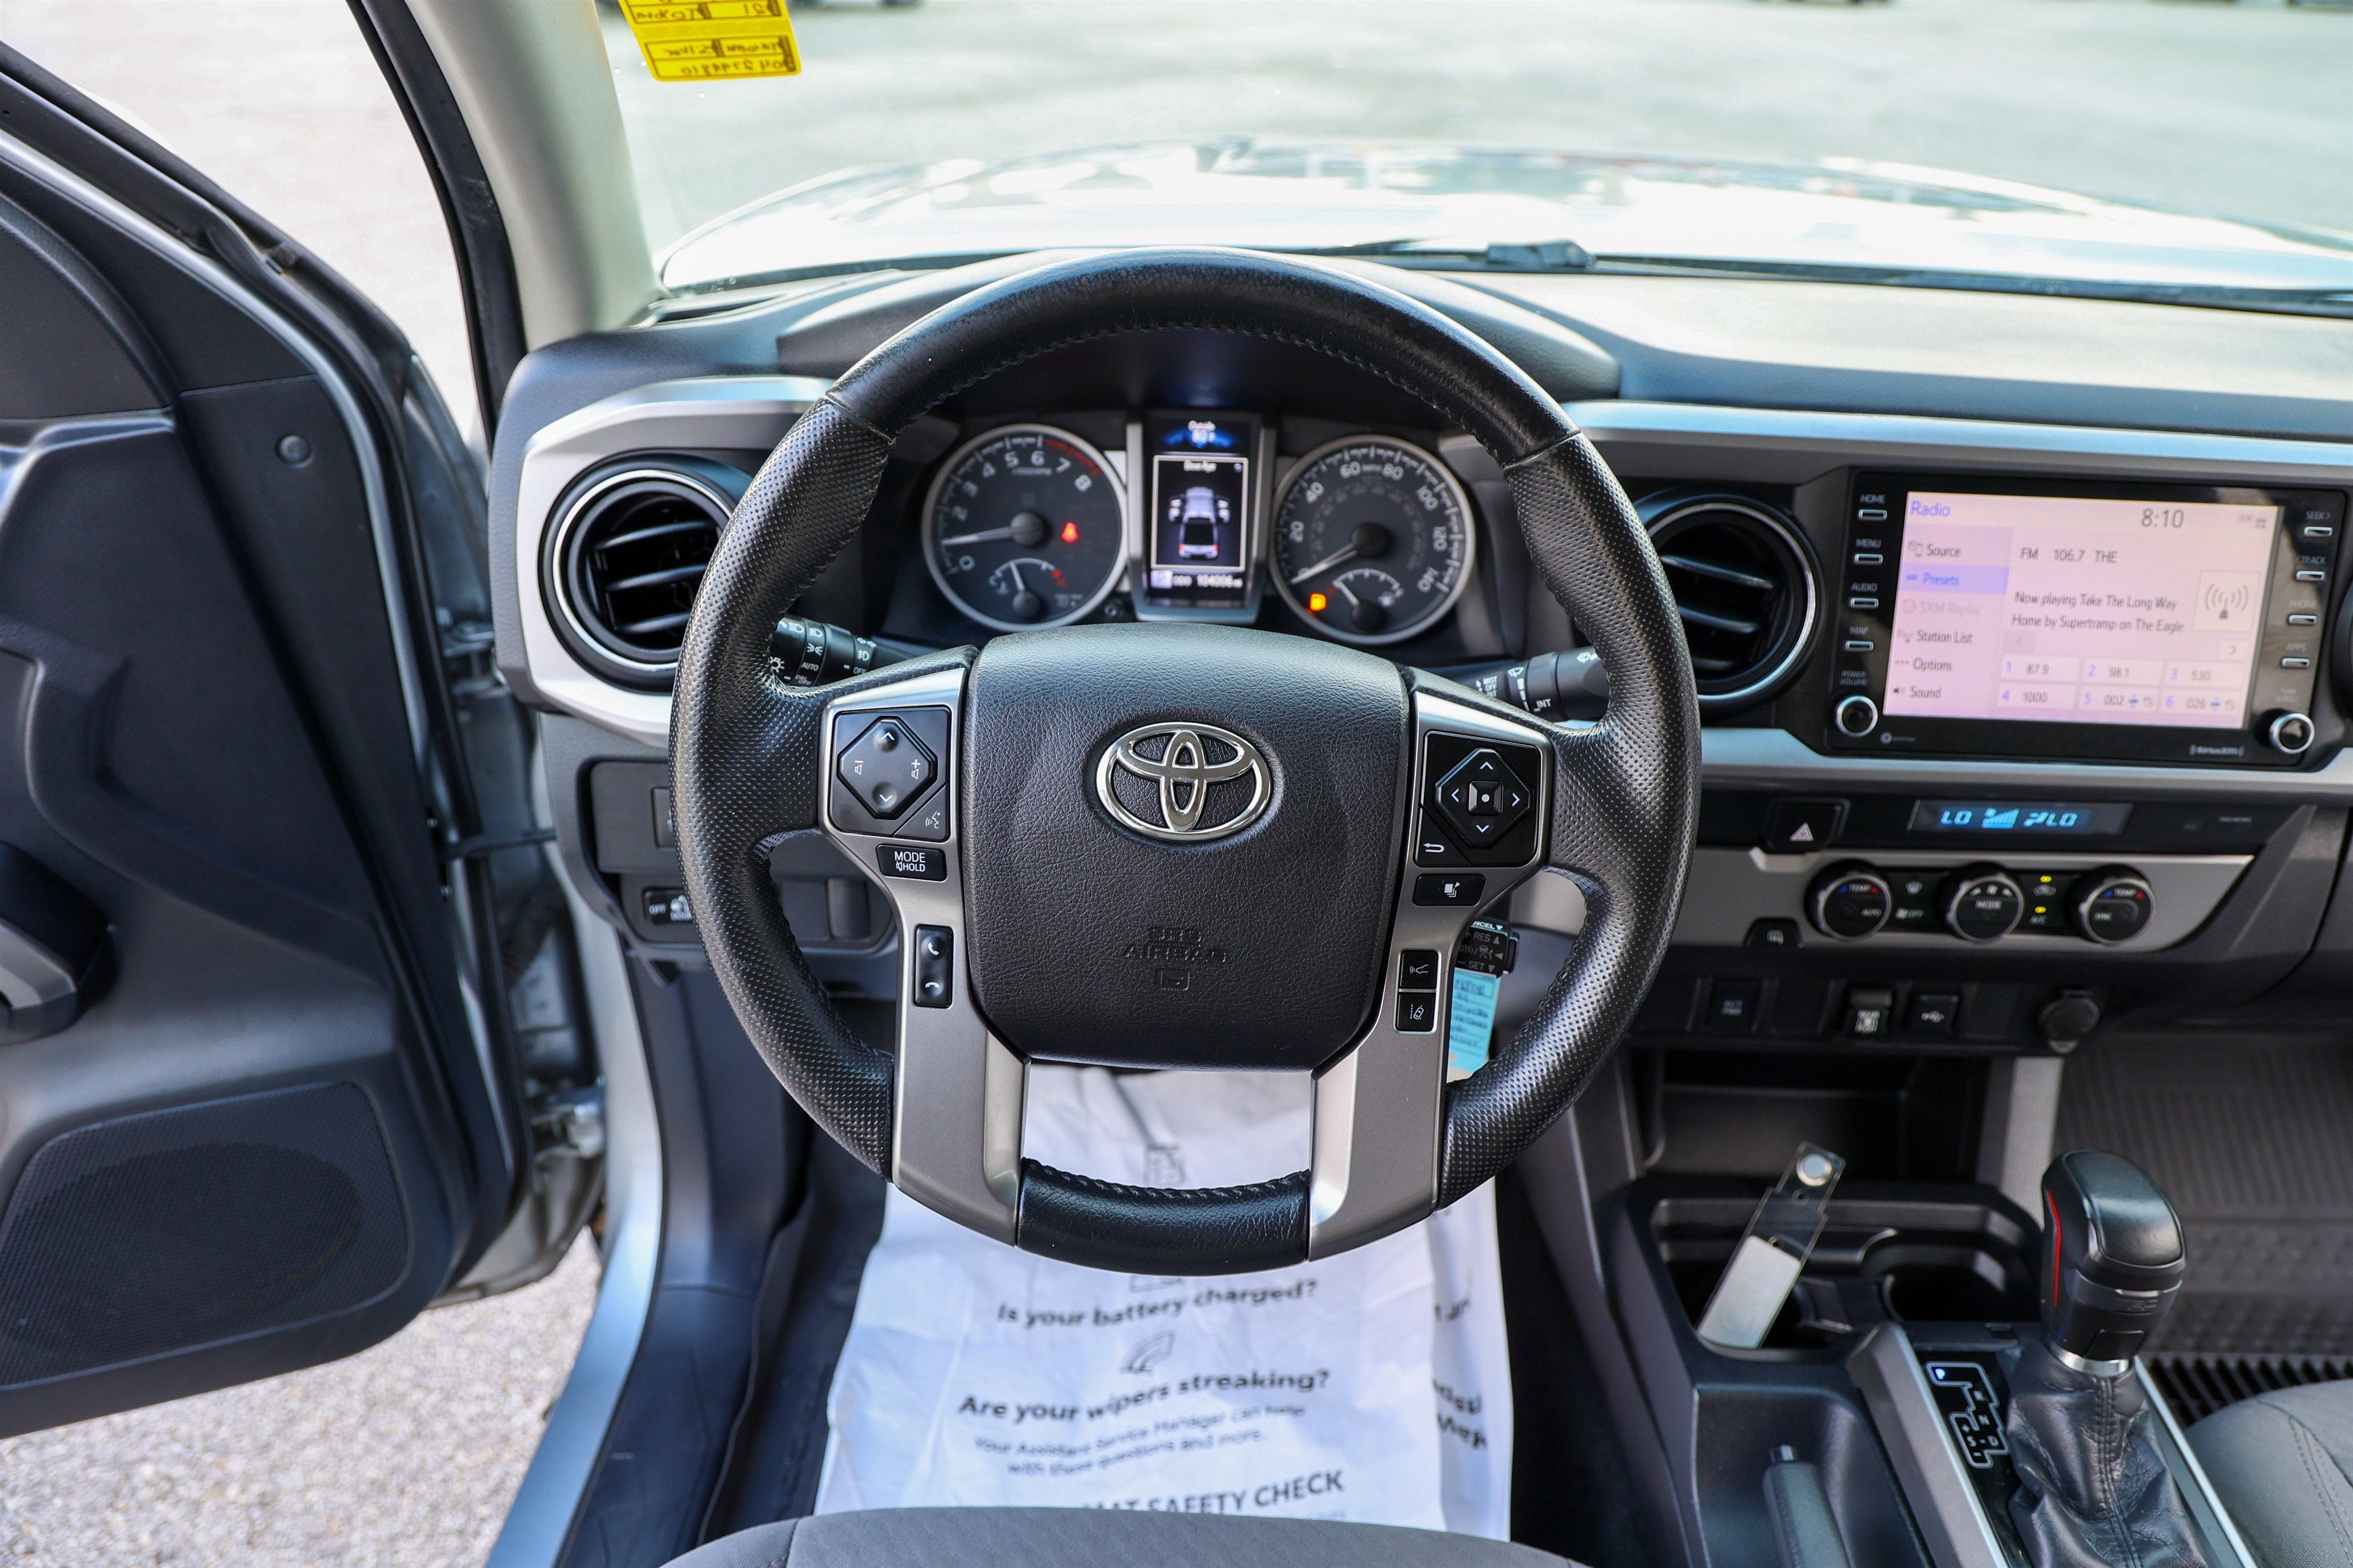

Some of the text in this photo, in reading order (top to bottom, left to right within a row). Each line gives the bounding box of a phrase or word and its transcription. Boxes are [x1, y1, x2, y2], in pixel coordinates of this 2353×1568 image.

[1005, 451, 1020, 469] 5
[1031, 450, 1045, 466] 6
[1056, 457, 1071, 473] 7
[982, 461, 996, 478] 4
[1340, 461, 1361, 478] 60
[1382, 462, 1405, 481] 80
[1074, 474, 1092, 492] 8
[1305, 481, 1325, 504] 40
[1415, 485, 1438, 511] 100
[1860, 494, 1886, 504] HOME
[1911, 500, 1951, 517] Radio
[2141, 508, 2185, 528] 8:10
[1289, 520, 1305, 543] 20
[1432, 526, 1448, 552] 120
[1856, 538, 1882, 548] MENU
[1927, 543, 1962, 557] Source
[2020, 547, 2119, 563] FM 106.7 THE
[959, 555, 975, 571] 0
[1850, 582, 1878, 592] AUDIO
[1923, 573, 1961, 586] Presets
[2014, 591, 2178, 612] Now playing Take The Long Way
[1849, 625, 1869, 635] MAP
[2011, 614, 2184, 635] Home by Supertramp on The Eagle
[1916, 629, 1973, 644] Station List
[800, 661, 820, 672] AUTO
[1912, 657, 1953, 672] Options
[2026, 663, 2050, 675] 87.9
[2087, 663, 2097, 677] 2
[1482, 675, 1498, 685] MIST
[1484, 683, 1497, 692] OFF
[1910, 685, 1942, 700] Sound
[2002, 689, 2010, 701] 4
[1536, 698, 1552, 709] INT
[2165, 695, 2174, 708] 6
[1941, 810, 1973, 825] LO
[2046, 812, 2078, 827] LO
[894, 851, 926, 863] MODE
[902, 862, 926, 872] HOLD
[1472, 920, 1495, 930] NCEL
[1473, 932, 1491, 943] RES
[1468, 960, 1486, 971] SET
[998, 1279, 1317, 1330] Is your battery charged?
[958, 1368, 1331, 1425] Are your wipers streaking?
[1179, 1435, 1214, 1451] and
[1148, 1490, 1247, 1514] SAFETY
[1253, 1469, 1344, 1507] CHECK
